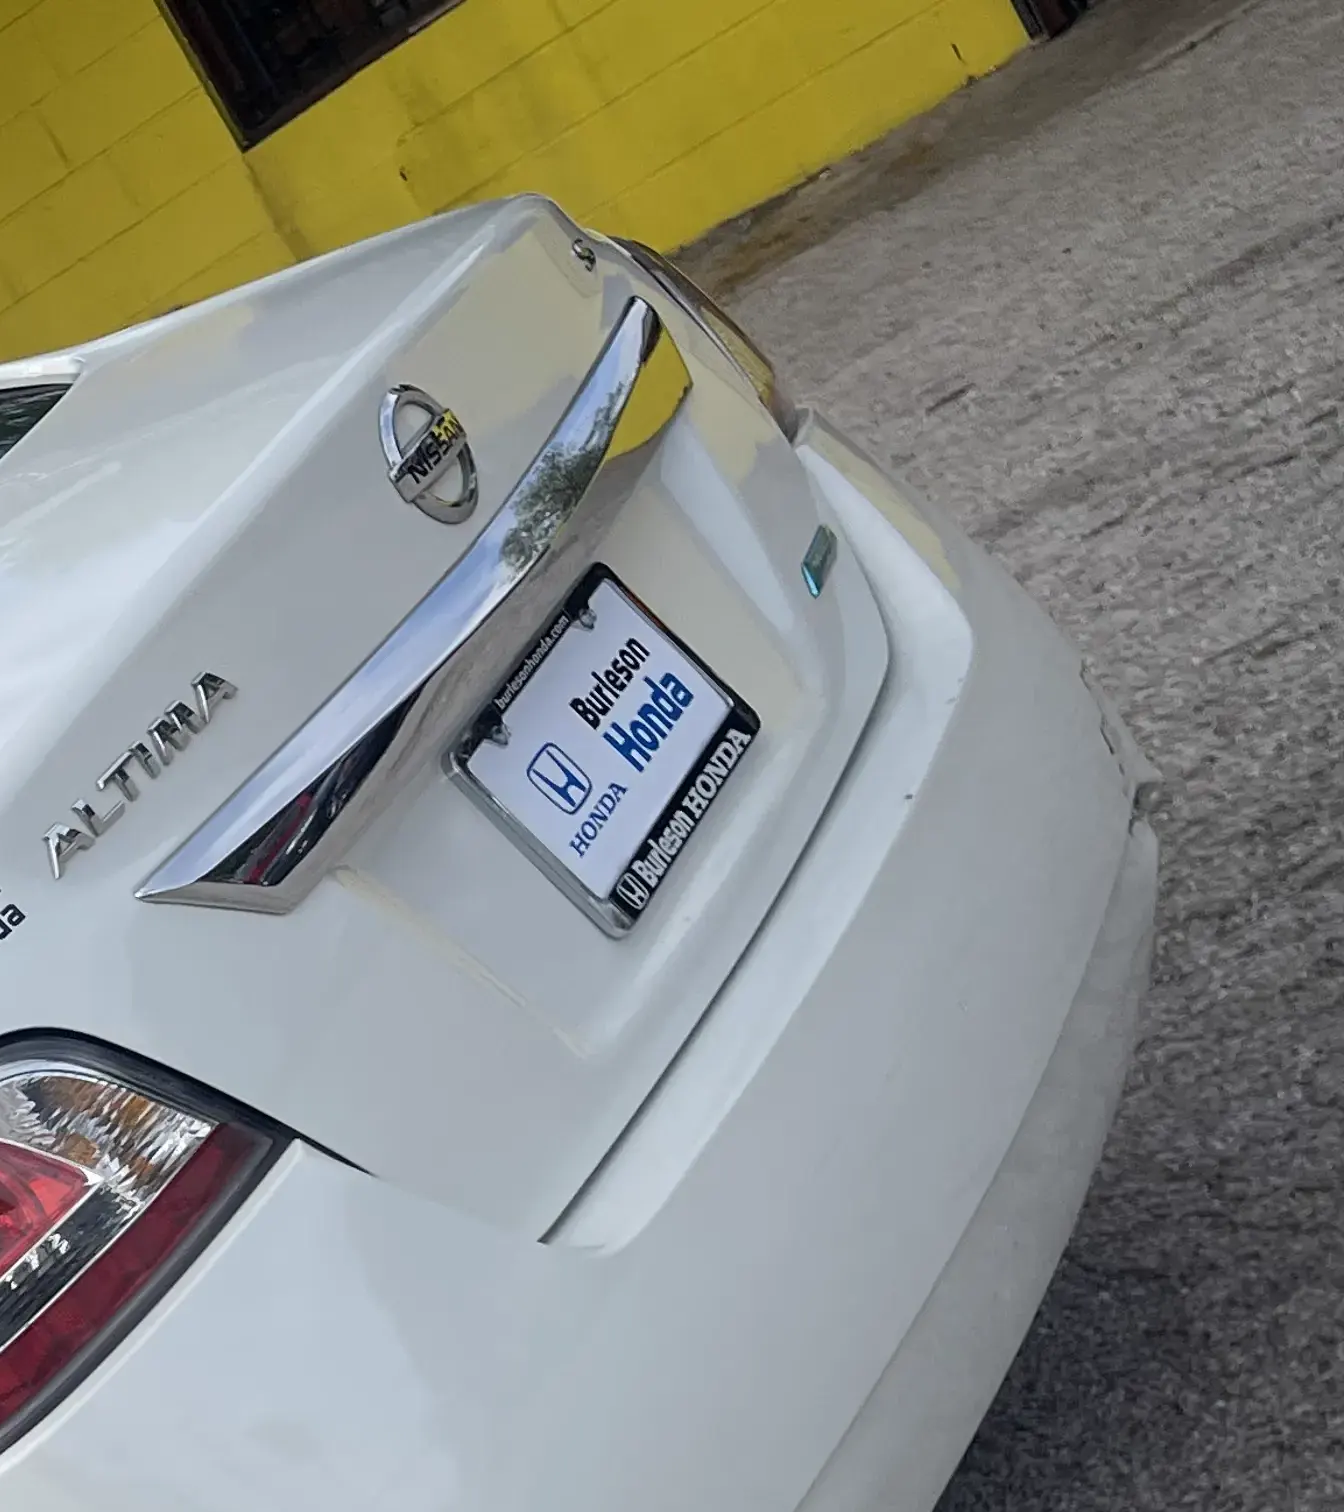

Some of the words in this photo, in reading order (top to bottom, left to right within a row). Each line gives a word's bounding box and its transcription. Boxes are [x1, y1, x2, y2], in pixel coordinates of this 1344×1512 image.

[407, 416, 466, 485] NISSAN
[494, 615, 570, 711] burlesonhonda.com
[570, 637, 650, 730] Burleson
[602, 672, 694, 773] Honda
[42, 671, 238, 880] ALTIMA
[569, 782, 628, 858] HONDA
[632, 809, 695, 888] Burleson
[682, 727, 752, 823] HONDA
